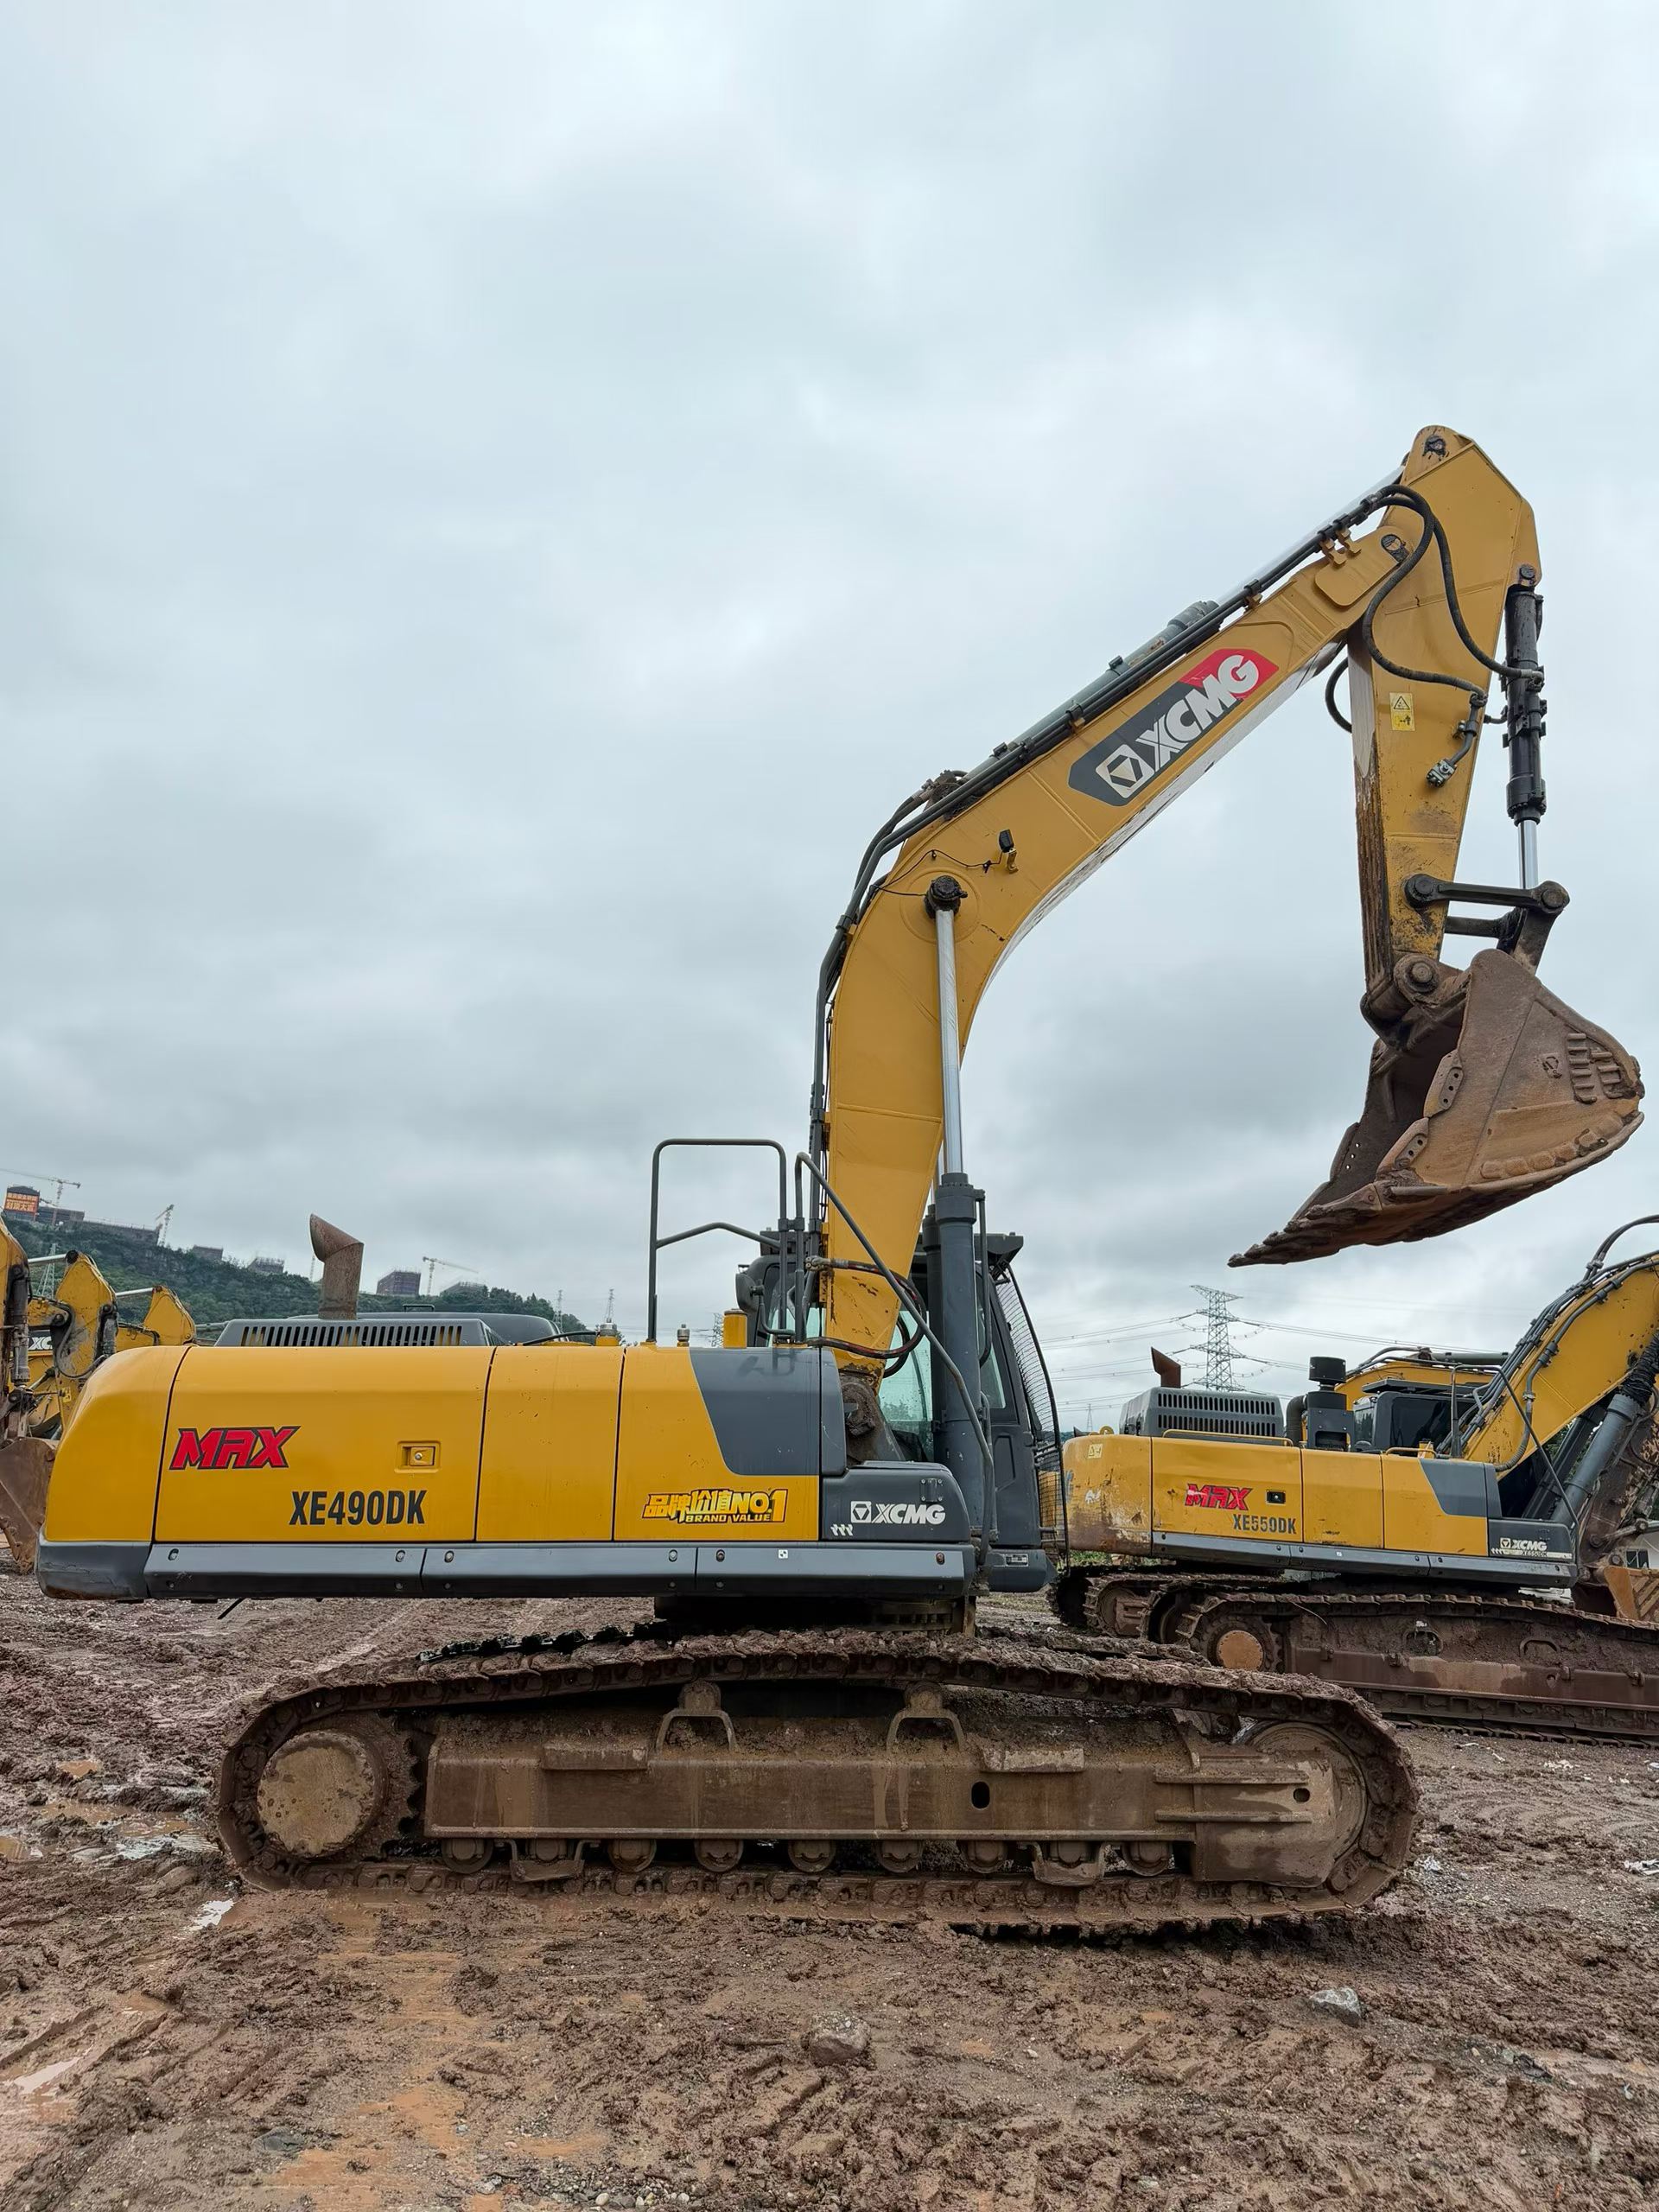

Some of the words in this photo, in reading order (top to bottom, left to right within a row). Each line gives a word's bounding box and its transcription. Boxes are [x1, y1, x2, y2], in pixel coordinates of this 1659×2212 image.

[1135, 655, 1259, 772] XCMG
[28, 1337, 52, 1349] XC
[169, 1426, 302, 1470] MAX
[289, 1491, 427, 1525] XE490DK
[1185, 1484, 1253, 1510] MAX
[685, 1514, 727, 1523] BRAND
[733, 1514, 771, 1522] VALUE
[871, 1503, 946, 1525] XCMG
[1233, 1514, 1296, 1534] XE550DK
[1511, 1540, 1548, 1551] XCMG
